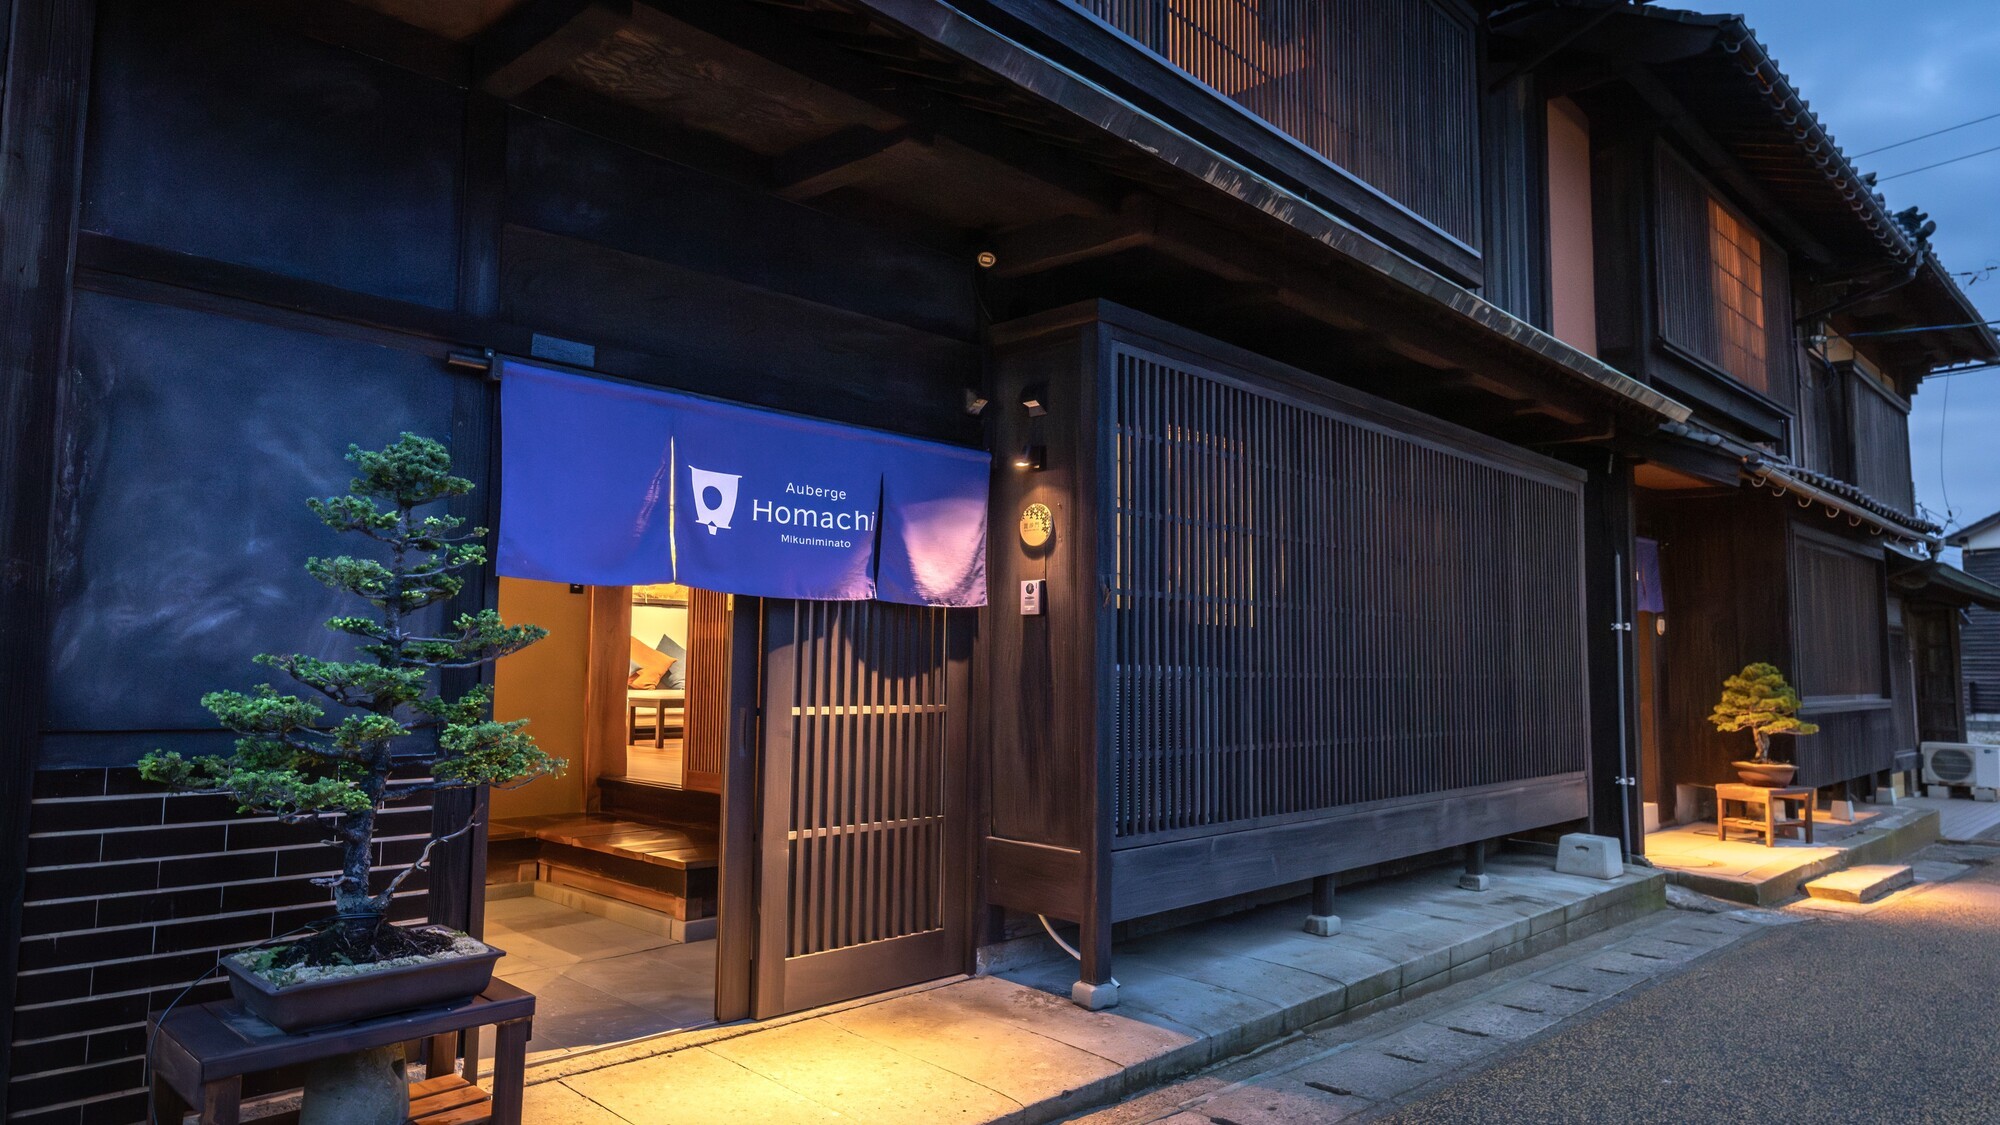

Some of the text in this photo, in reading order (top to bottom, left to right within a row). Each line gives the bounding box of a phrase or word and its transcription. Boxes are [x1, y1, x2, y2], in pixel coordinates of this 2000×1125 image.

[785, 482, 847, 502] Auberge
[752, 499, 875, 532] Homachi
[781, 534, 851, 549] Mikuniminato
